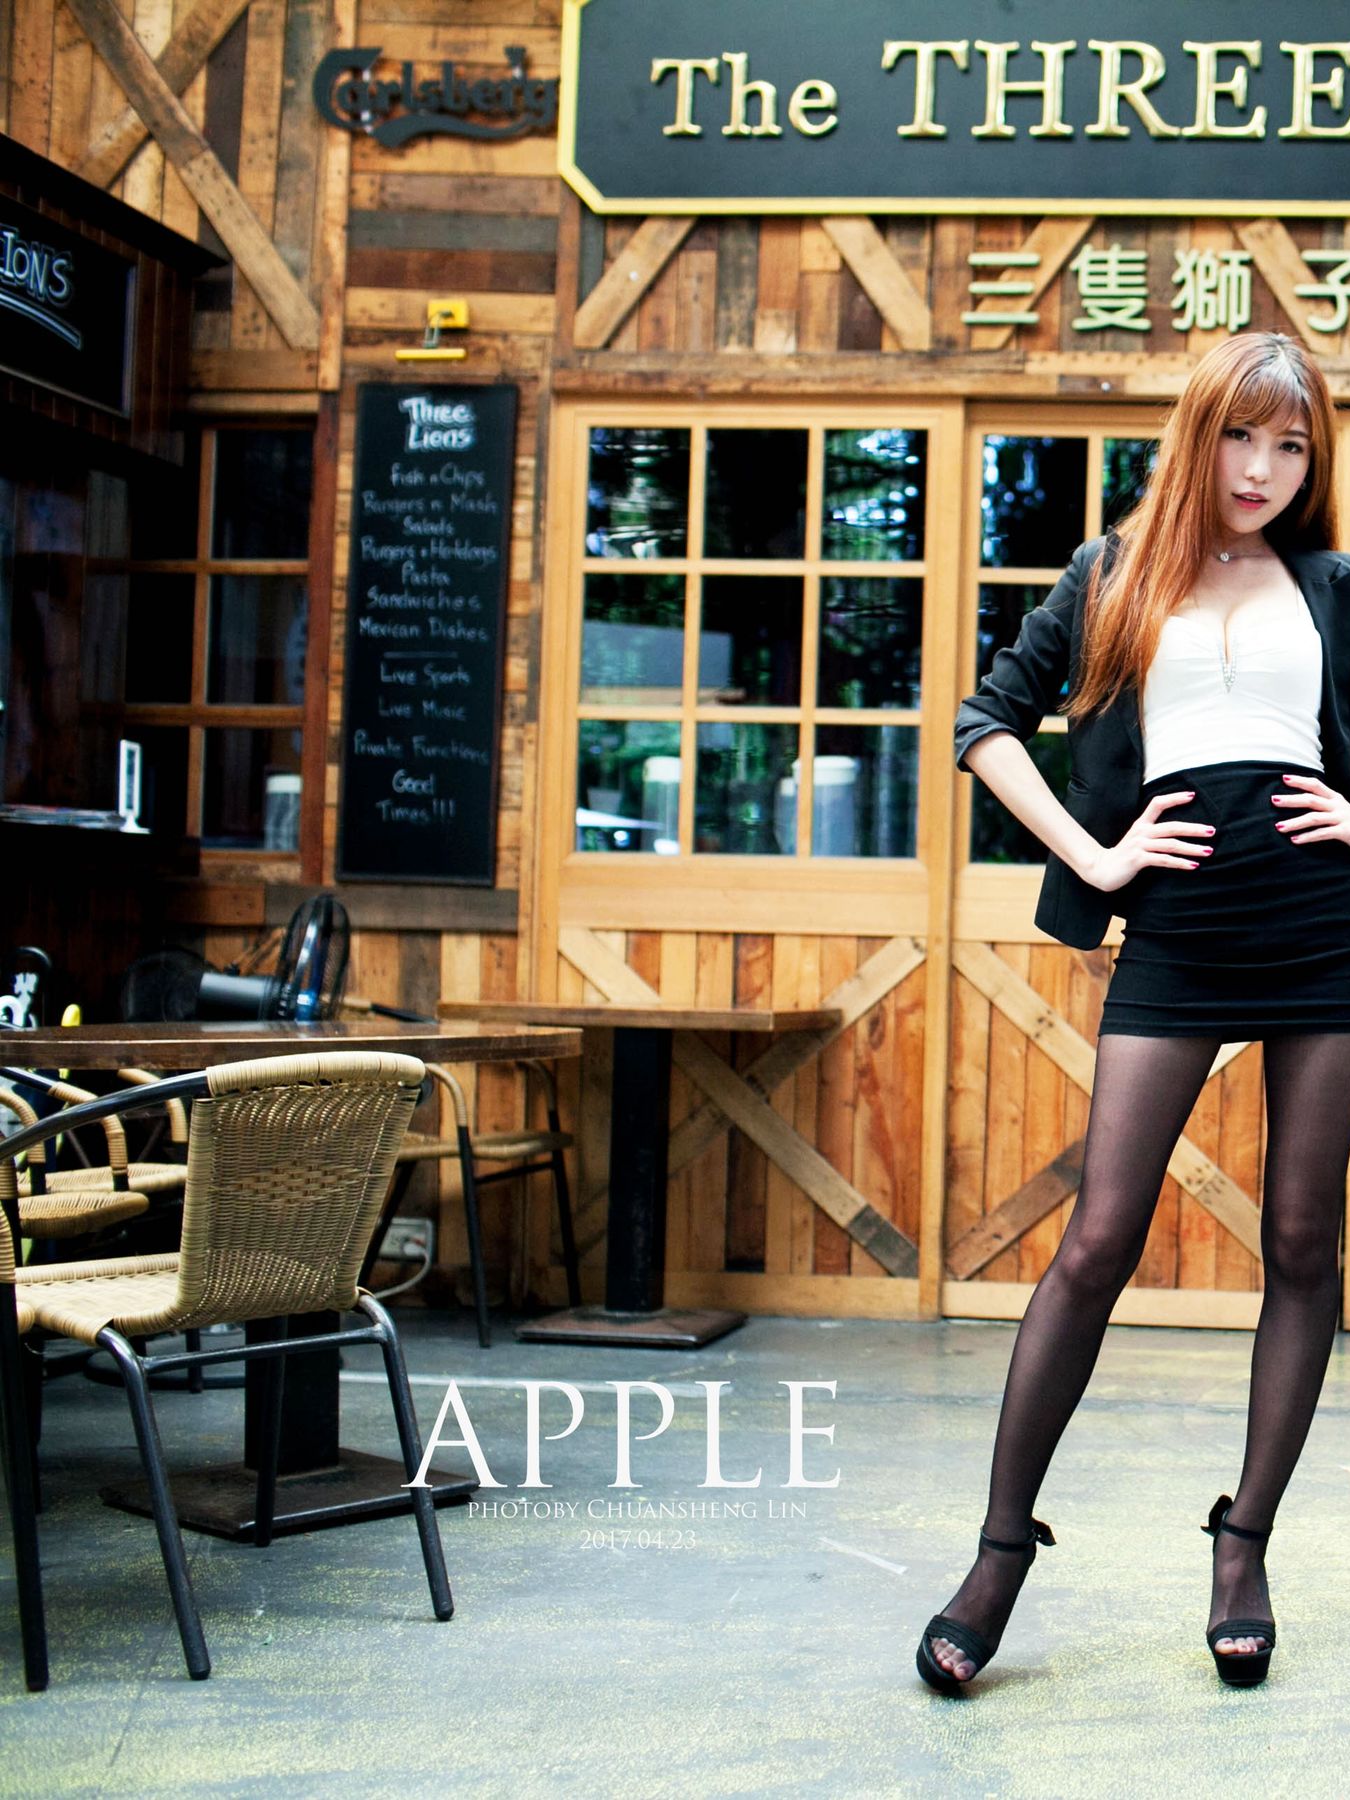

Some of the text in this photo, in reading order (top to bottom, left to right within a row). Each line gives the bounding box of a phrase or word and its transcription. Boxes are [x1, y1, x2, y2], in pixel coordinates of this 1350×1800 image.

[312, 46, 560, 146] Carlsberg
[650, 52, 840, 137] The
[0, 230, 69, 298] IONS
[399, 396, 473, 425] Three
[406, 424, 474, 452] Lions
[380, 661, 417, 685] Live
[391, 768, 435, 795] Good
